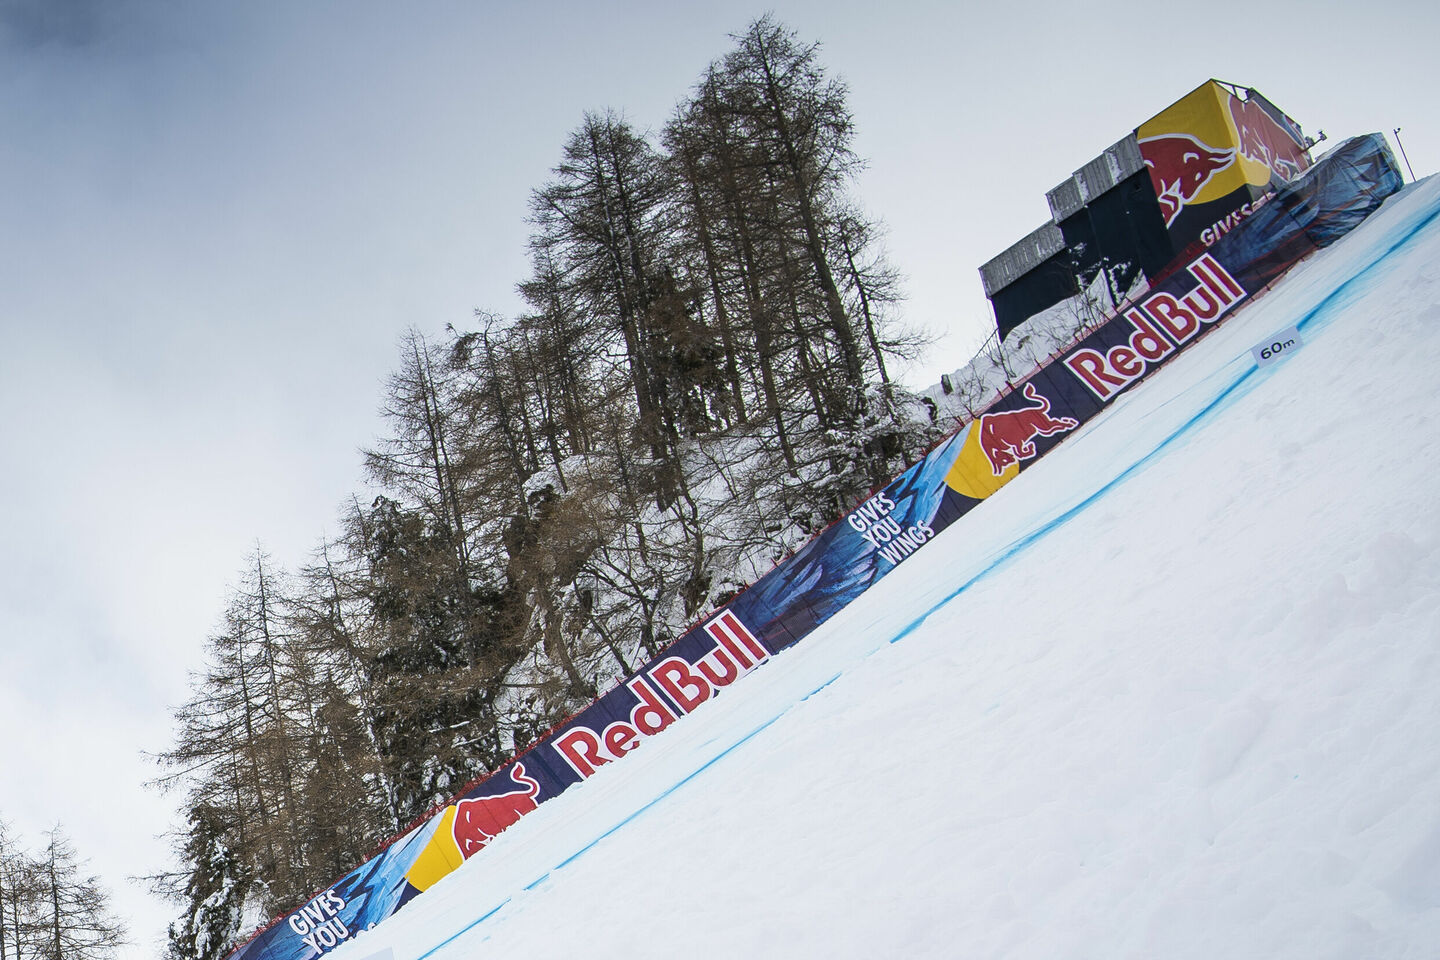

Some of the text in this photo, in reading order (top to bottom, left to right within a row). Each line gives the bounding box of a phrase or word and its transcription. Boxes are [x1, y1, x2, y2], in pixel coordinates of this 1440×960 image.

[1063, 253, 1247, 402] Red Bull
[1260, 339, 1295, 360] 60m
[847, 491, 896, 533] GIVES
[861, 515, 902, 549] YOU
[877, 519, 935, 566] WINGS
[551, 608, 770, 781] Red Bull
[288, 889, 346, 936] GIVES
[301, 916, 349, 955] YOU
